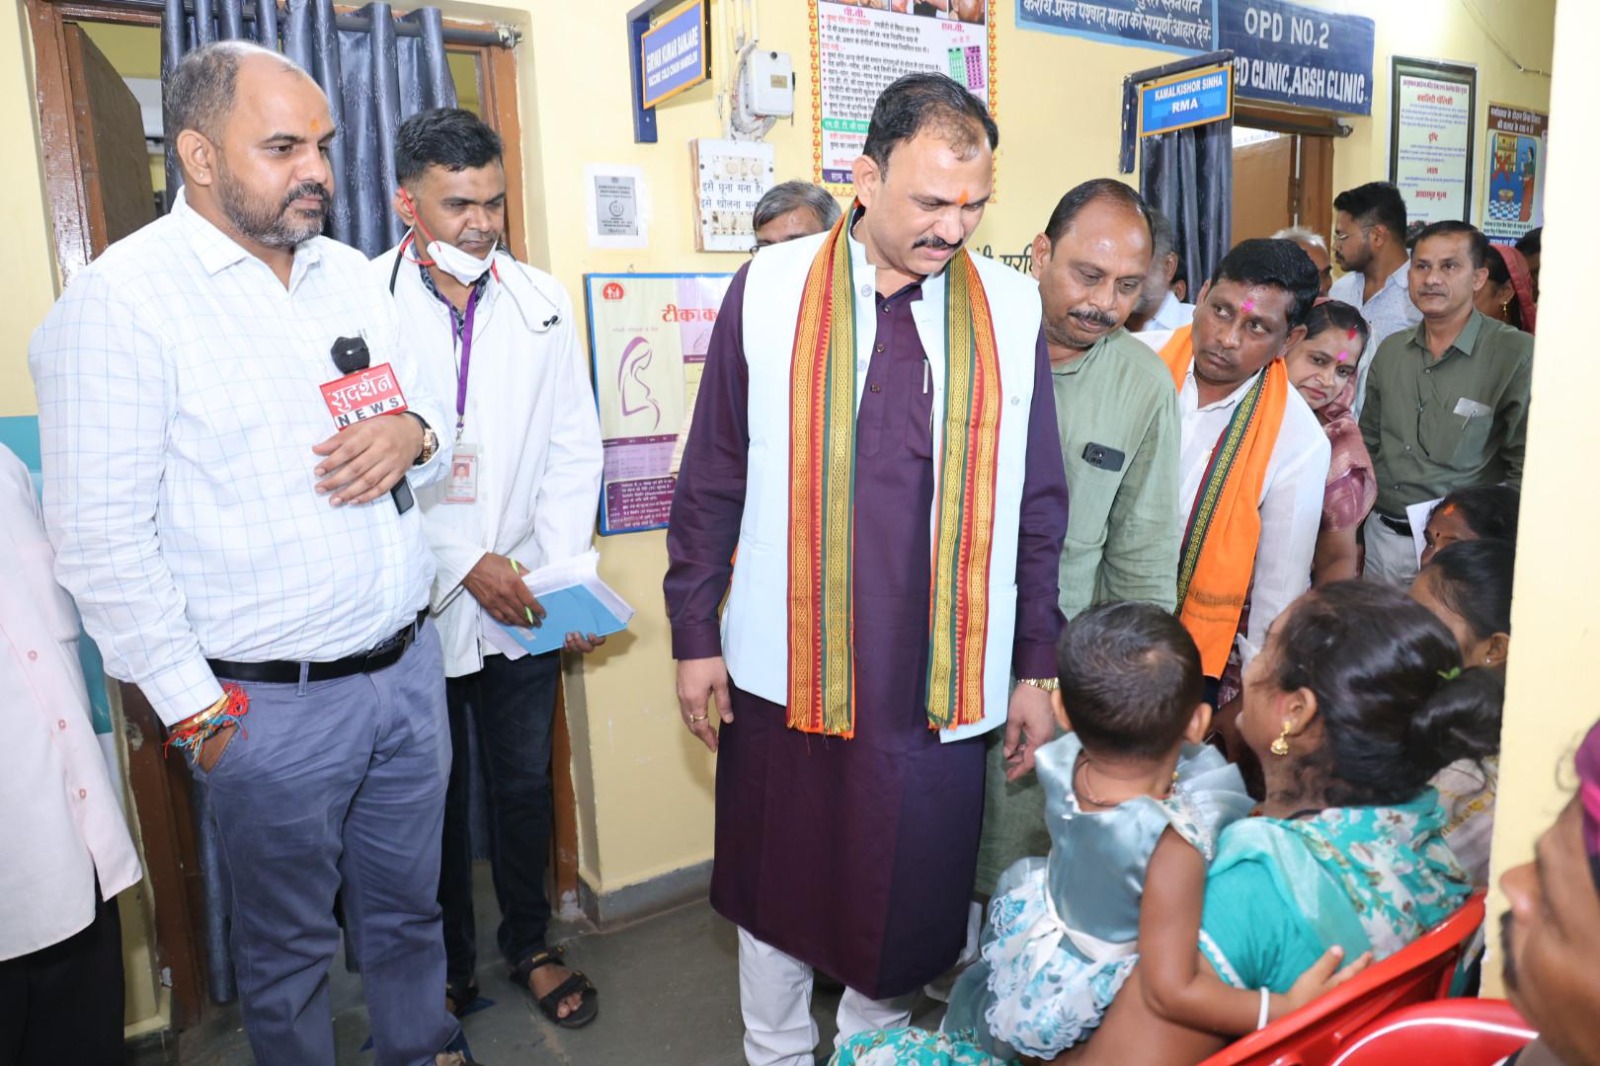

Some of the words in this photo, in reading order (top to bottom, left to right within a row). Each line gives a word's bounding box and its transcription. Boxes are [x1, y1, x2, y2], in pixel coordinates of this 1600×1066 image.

[1108, 8, 1129, 31] माता
[1130, 8, 1144, 31] को
[1144, 13, 1172, 44] सम्पूर्ण
[1171, 20, 1196, 44] आहार
[1244, 7, 1283, 43] OPD
[1202, 74, 1222, 92] SINHA
[1223, 56, 1249, 87] CD
[1326, 70, 1365, 104] CLINIC
[1172, 97, 1198, 114] RMA
[738, 184, 751, 194] मना
[328, 372, 394, 414] सुदर्शन
[336, 396, 400, 428] NEWS
